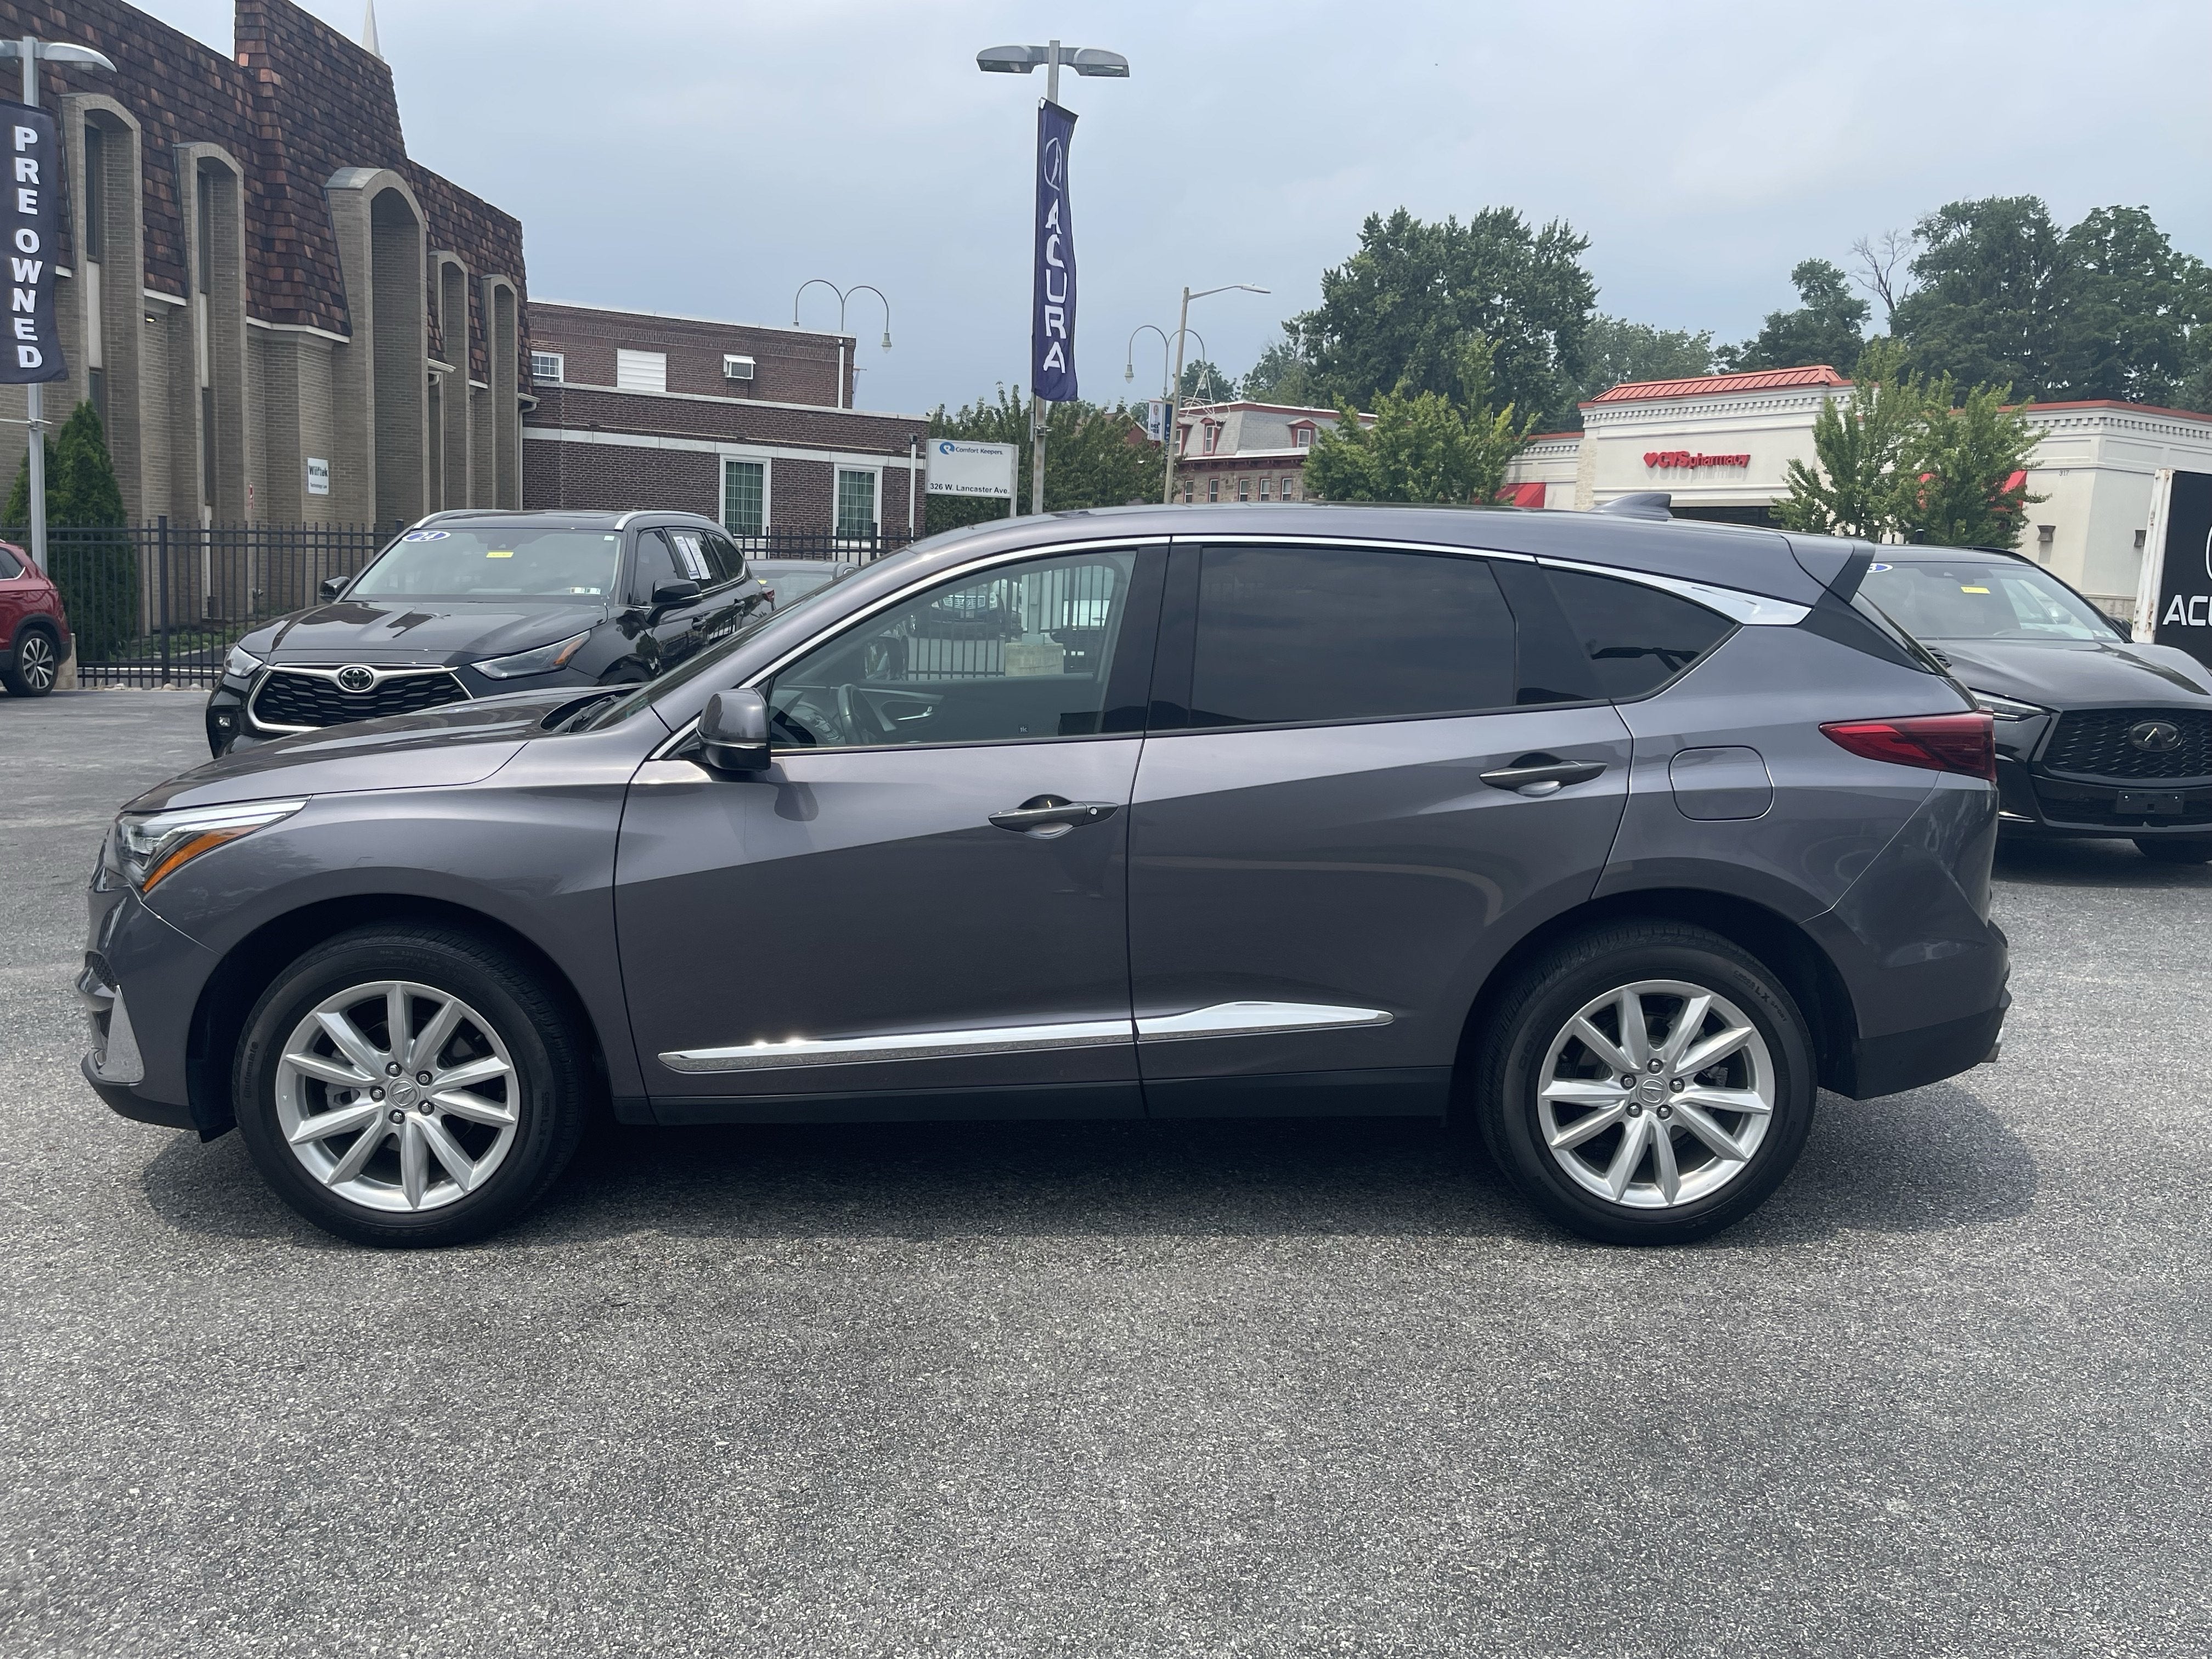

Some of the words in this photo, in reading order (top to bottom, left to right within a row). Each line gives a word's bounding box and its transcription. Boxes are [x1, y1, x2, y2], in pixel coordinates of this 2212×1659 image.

[14, 126, 40, 215] PRE
[11, 228, 43, 368] OWNED
[1043, 199, 1068, 374] ACURA
[956, 484, 992, 493] Lancaster
[2163, 594, 2212, 626] AC
[1755, 985, 1770, 1003] LX
